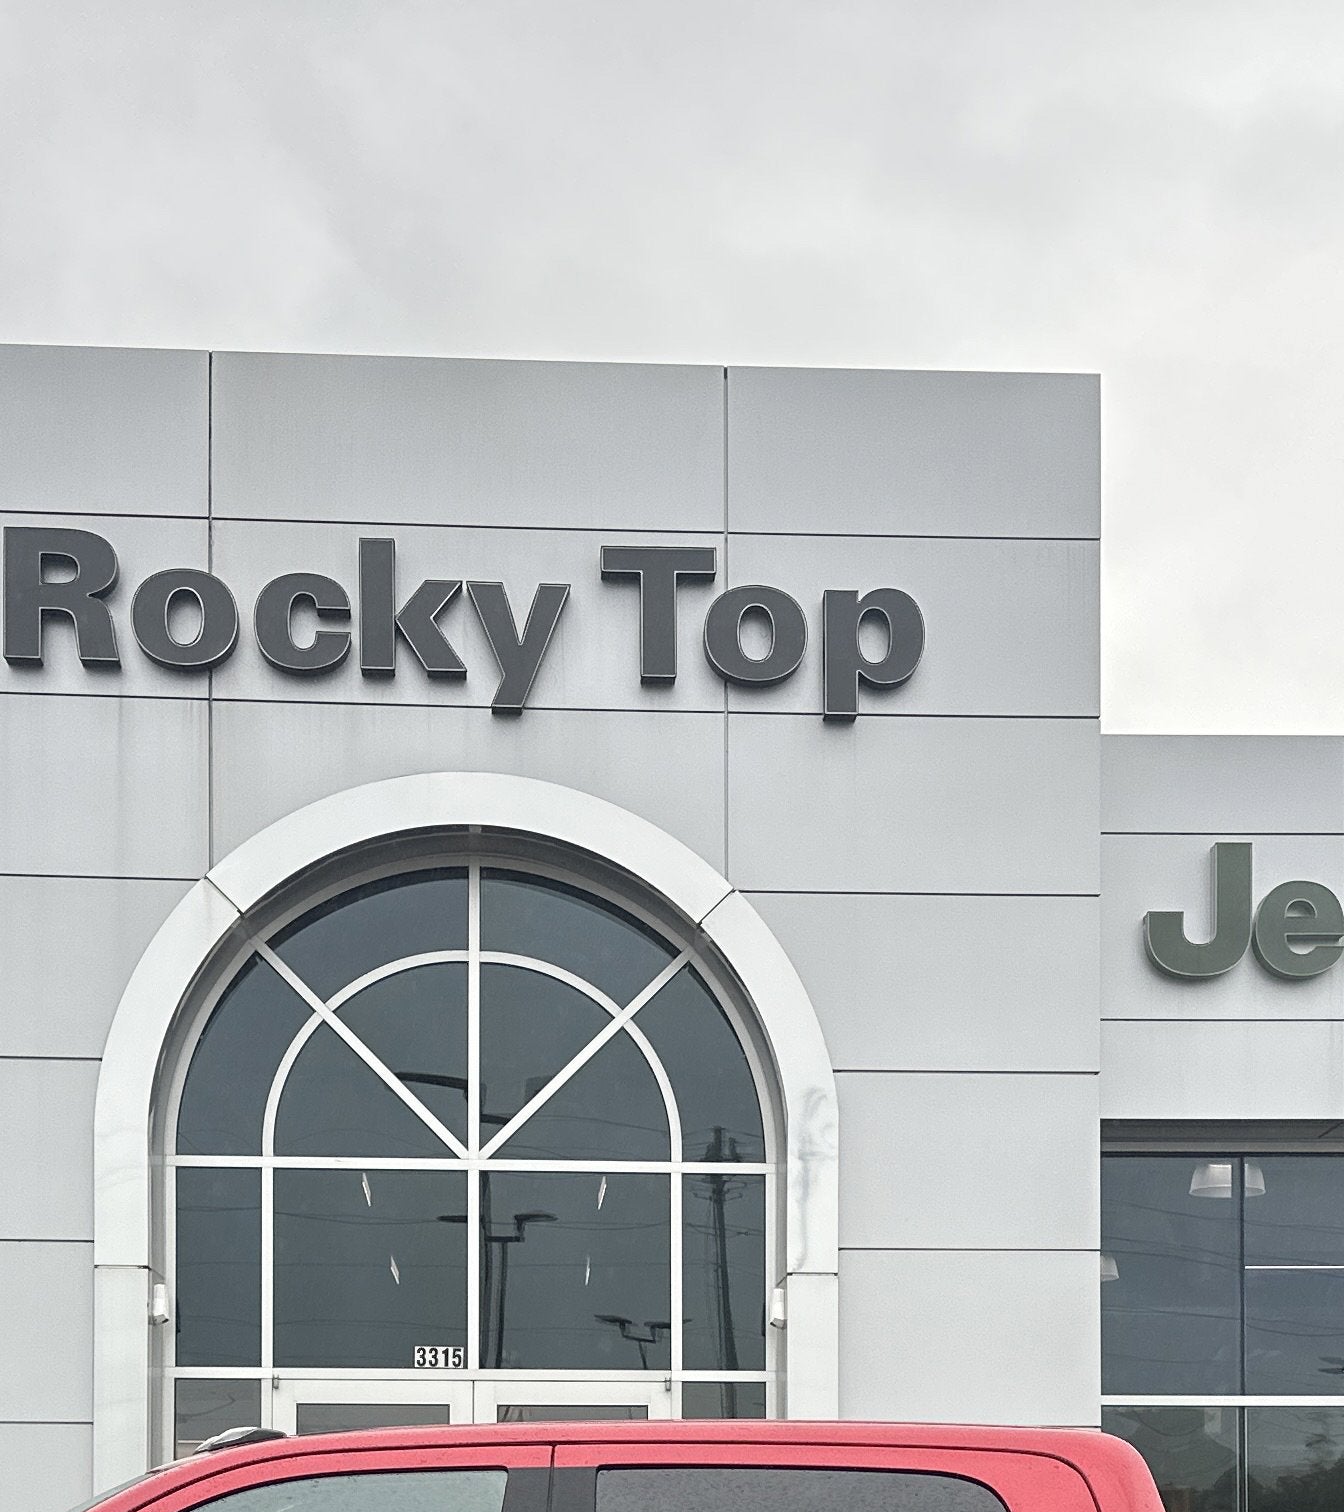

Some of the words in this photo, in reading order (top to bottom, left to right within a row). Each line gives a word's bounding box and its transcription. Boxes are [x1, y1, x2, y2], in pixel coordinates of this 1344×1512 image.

[3, 526, 571, 714] Rocky
[600, 545, 926, 721] Top
[416, 1347, 462, 1367] 3315
